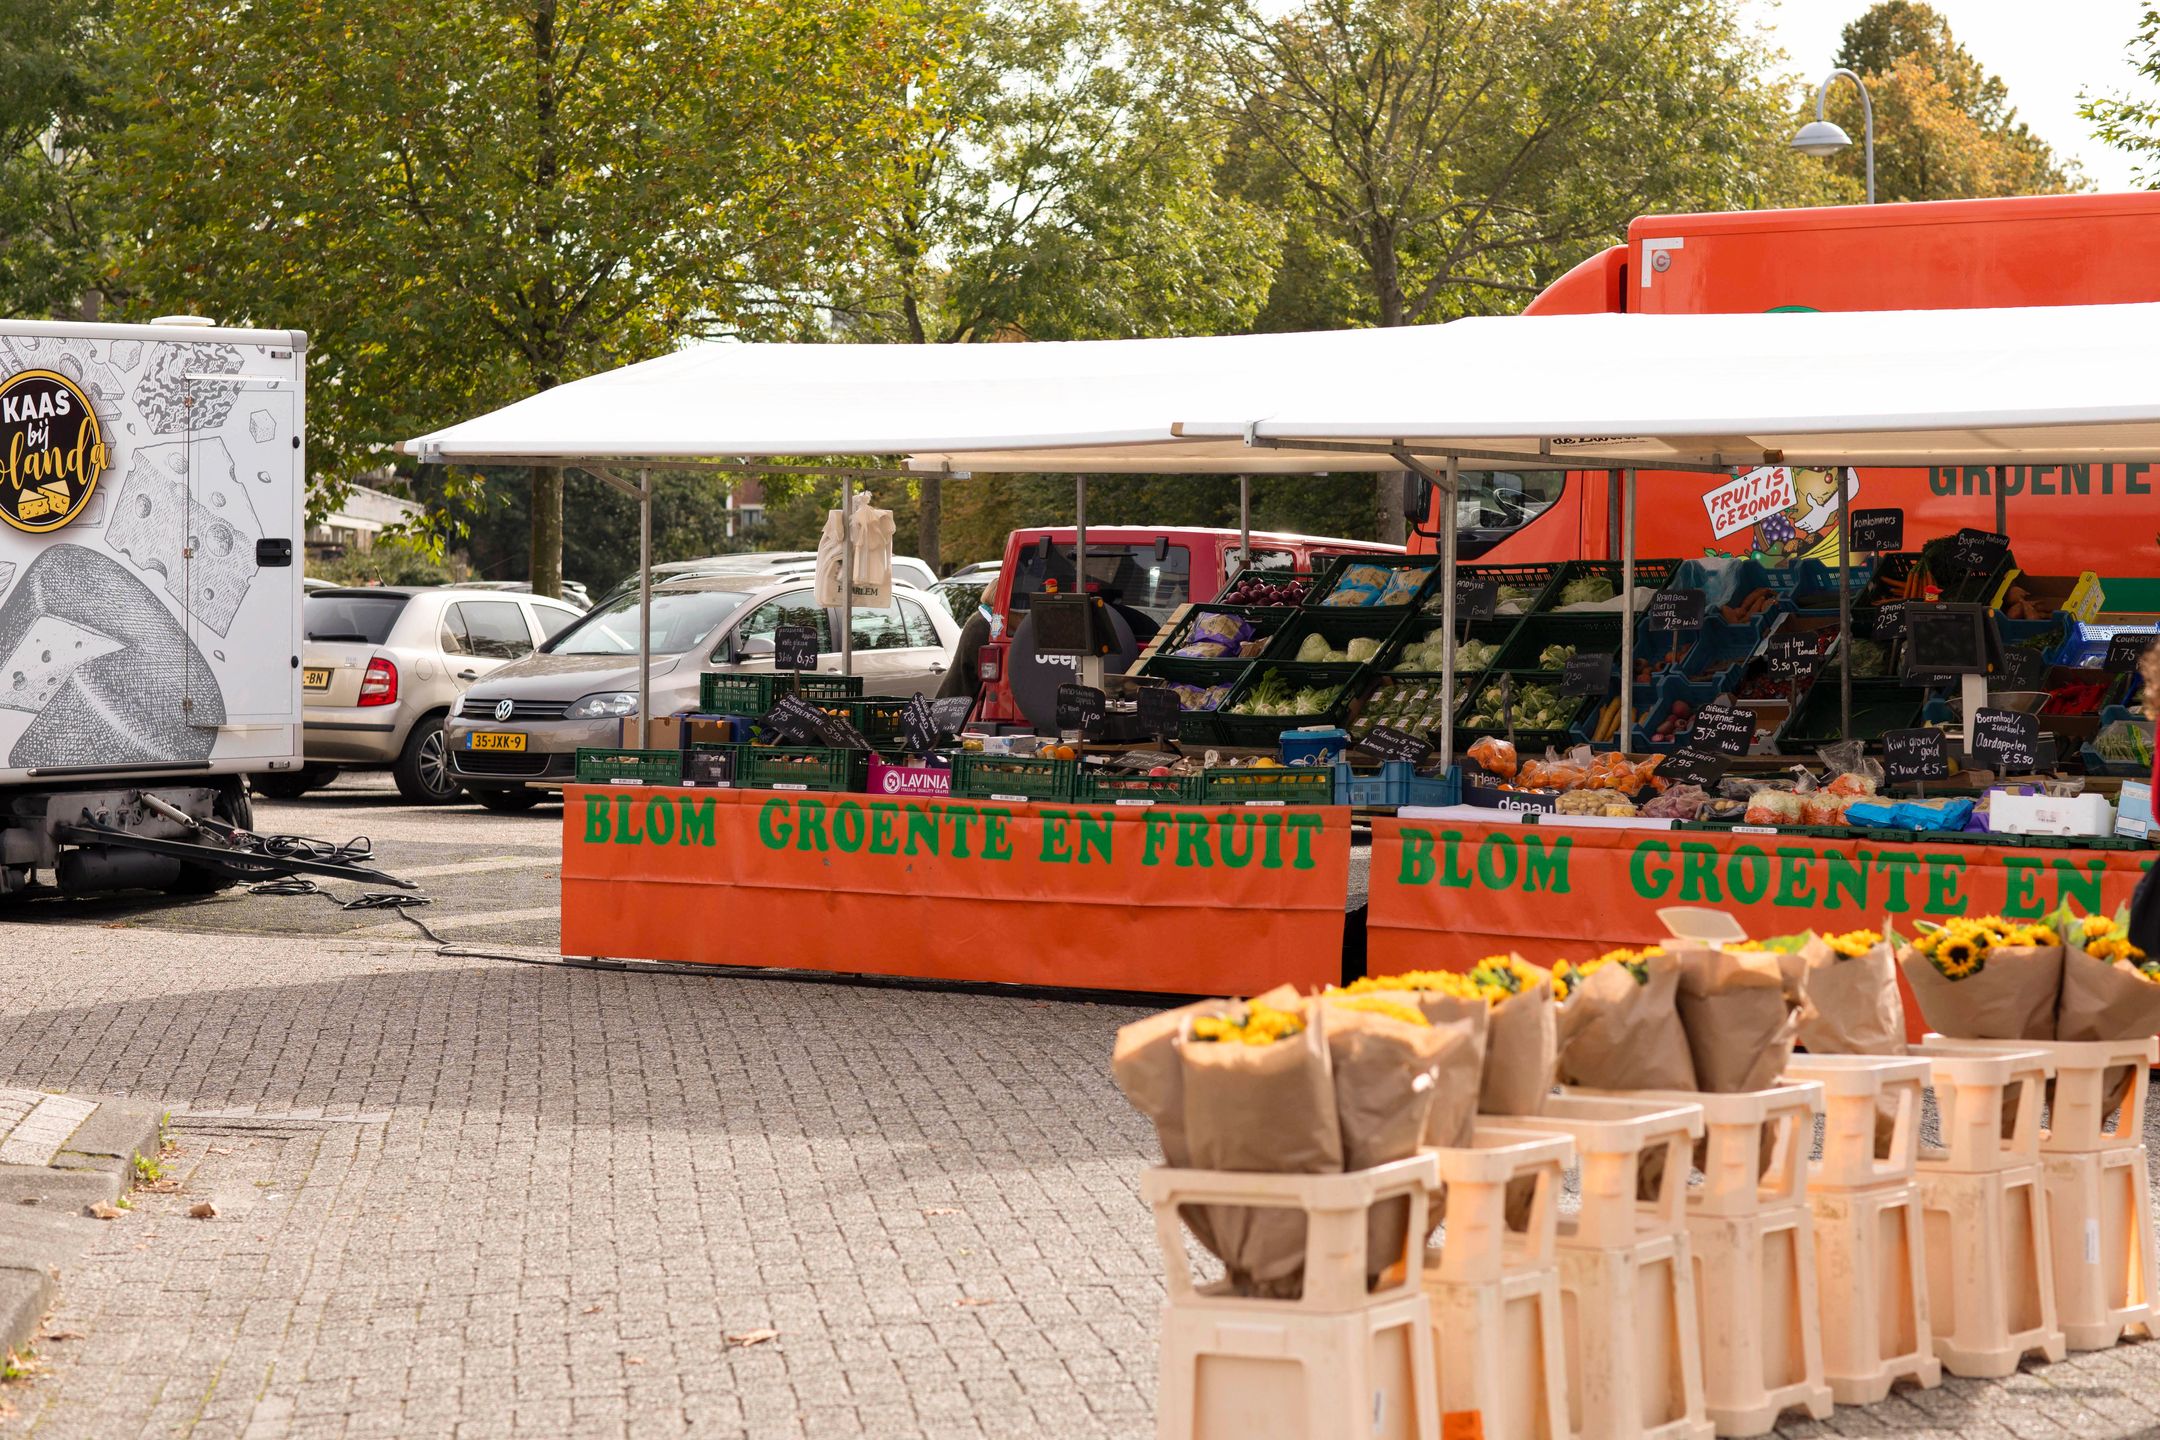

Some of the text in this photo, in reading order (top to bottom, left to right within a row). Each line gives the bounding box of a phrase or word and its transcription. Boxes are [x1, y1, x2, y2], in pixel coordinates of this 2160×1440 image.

[3, 389, 71, 424] KAAS
[28, 417, 50, 453] bij
[1711, 468, 1785, 514] FRUIT IS
[1716, 483, 1791, 531] GEZOND!
[837, 585, 879, 597] ARLEM
[475, 735, 522, 749] 35-JXK-9
[901, 773, 949, 789] LAVINIA
[584, 794, 1323, 870] BLOM GROENTE EN FRUIT
[1398, 827, 2106, 919] BLOM GROENTE EN
